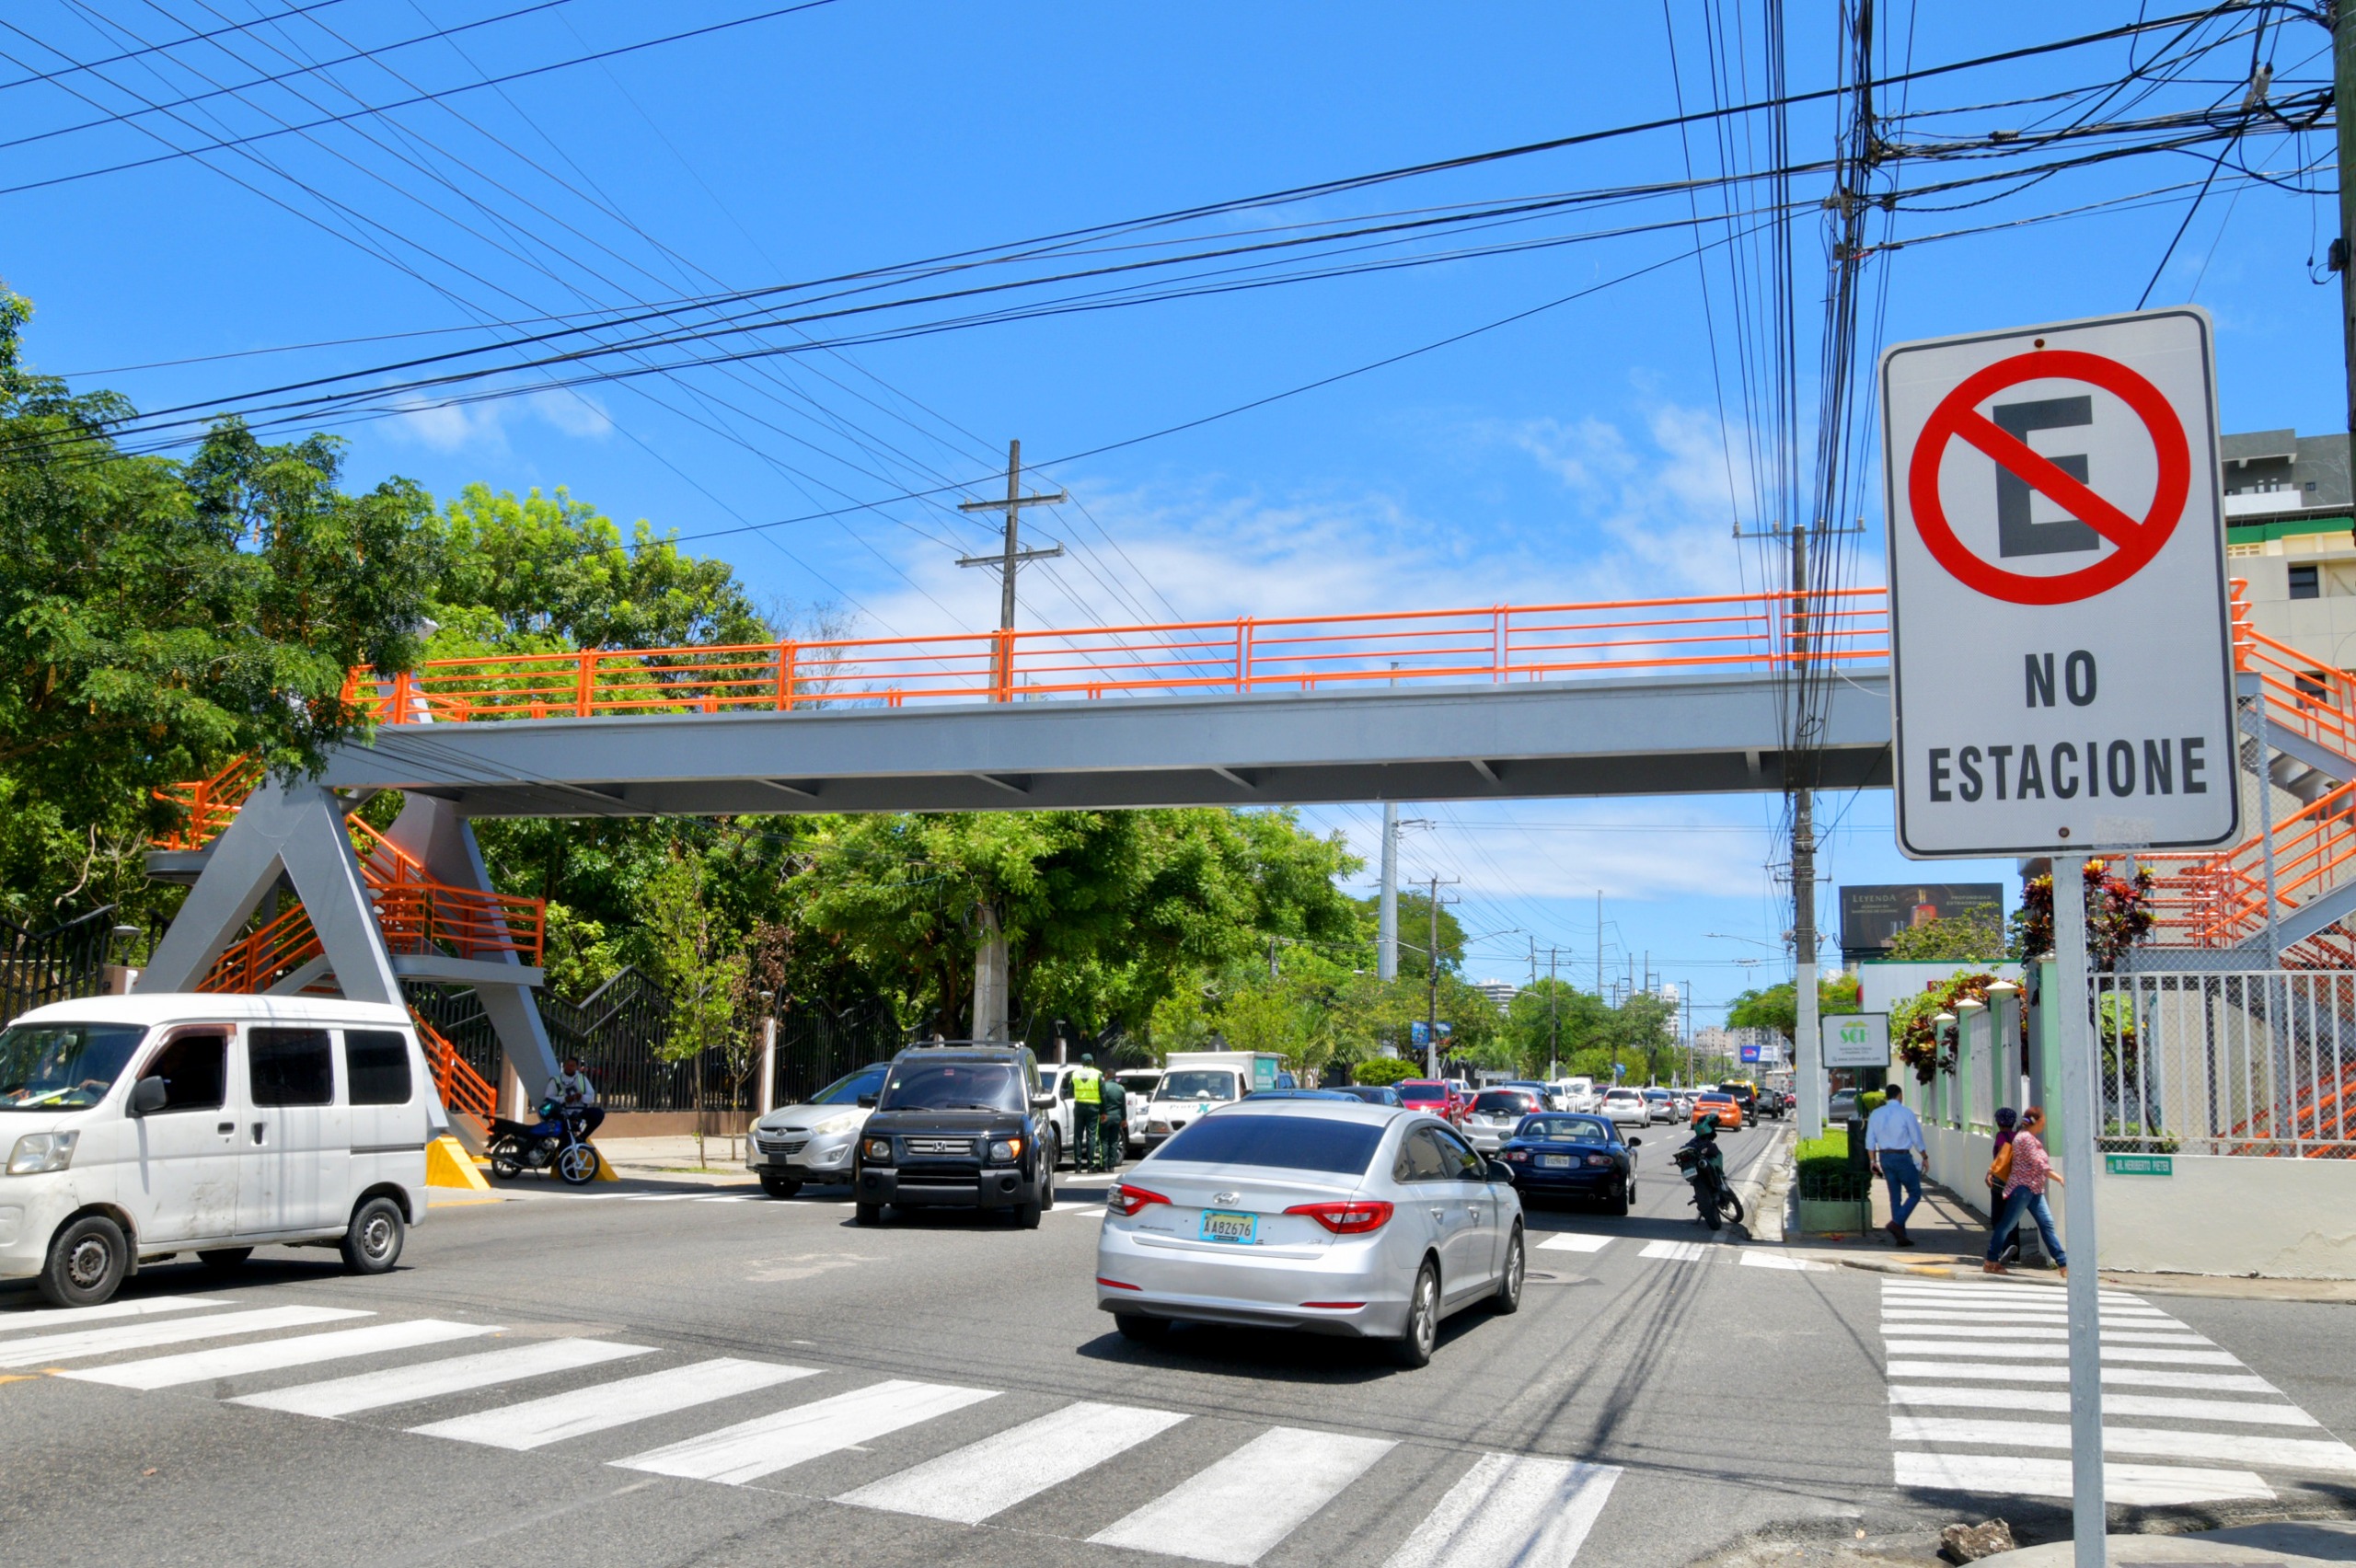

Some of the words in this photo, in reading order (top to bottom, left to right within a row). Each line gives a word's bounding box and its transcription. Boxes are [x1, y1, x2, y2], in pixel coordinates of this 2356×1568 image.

[1992, 395, 2100, 559] E
[2025, 650, 2097, 709] NO
[1928, 736, 2208, 803] ESTACIONE
[1853, 894, 1897, 903] LEYENDA
